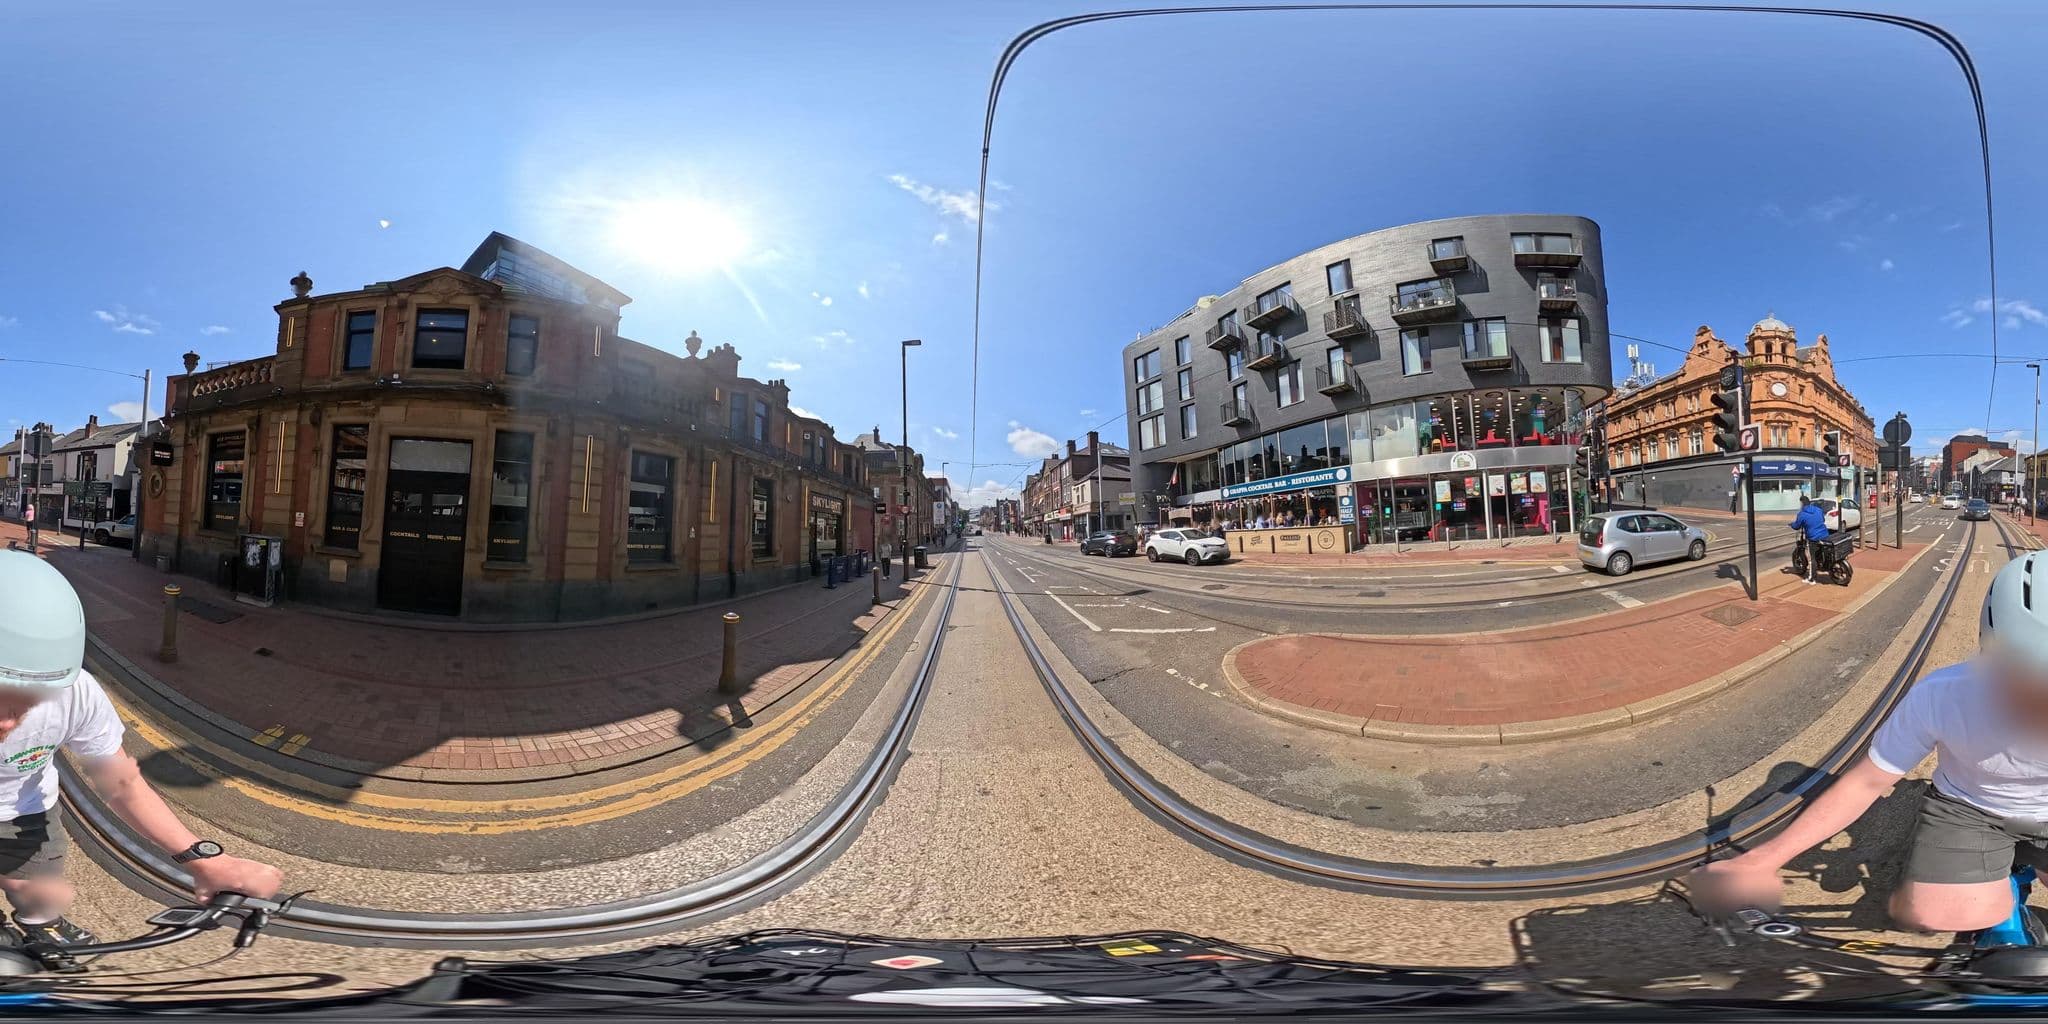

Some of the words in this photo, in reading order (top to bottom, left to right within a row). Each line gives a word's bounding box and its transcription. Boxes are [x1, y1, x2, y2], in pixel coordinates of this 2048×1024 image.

[1248, 482, 1274, 491] COCKTAIL
[1274, 480, 1287, 488] BAR
[1291, 473, 1334, 485] RISTORANTE
[812, 496, 842, 513] SKYLIGHT
[389, 531, 420, 539] COCKTAILS
